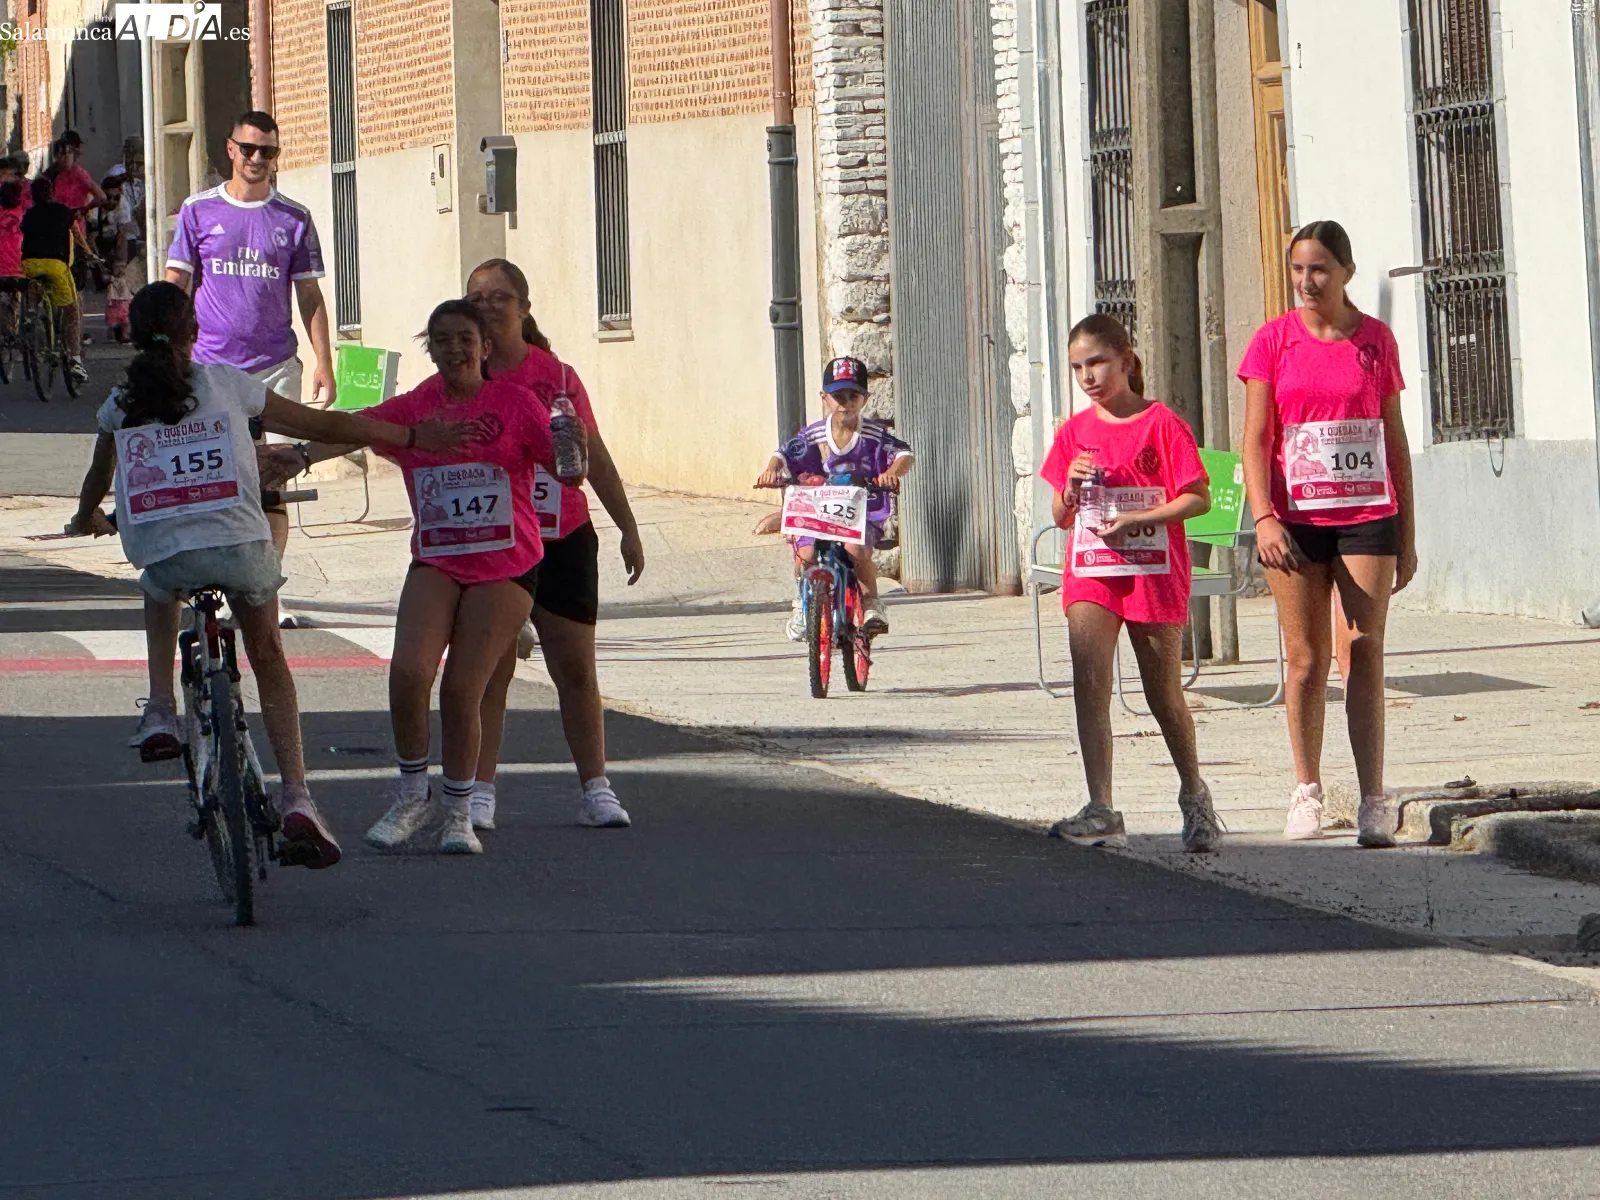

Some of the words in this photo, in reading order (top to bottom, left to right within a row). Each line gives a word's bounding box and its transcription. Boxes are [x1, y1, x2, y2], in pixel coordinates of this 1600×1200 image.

[237, 246, 259, 262] Fly
[211, 258, 280, 280] Emirates
[170, 448, 223, 476] 155
[1331, 451, 1374, 471] 104
[451, 494, 499, 517] 147
[820, 503, 857, 520] 125
